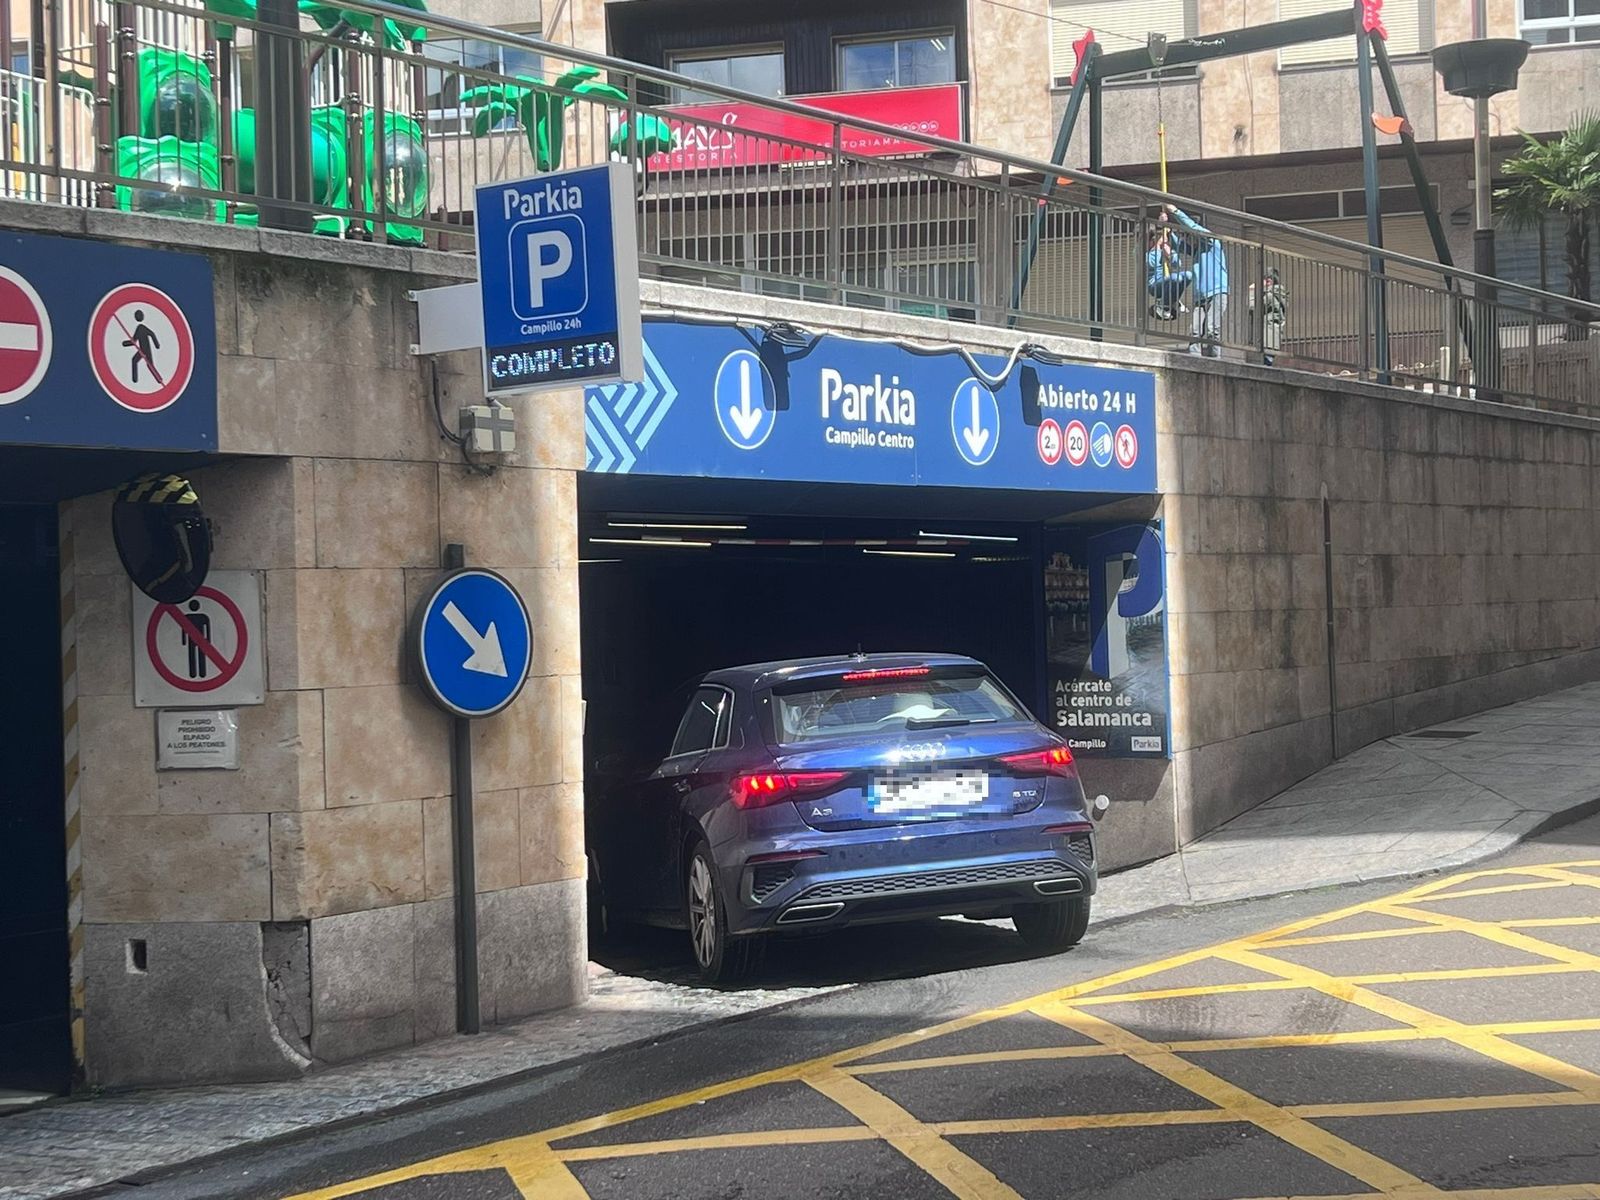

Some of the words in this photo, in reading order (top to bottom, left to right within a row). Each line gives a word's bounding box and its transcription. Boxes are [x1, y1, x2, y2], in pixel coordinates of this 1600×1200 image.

[503, 180, 583, 220] Parkia
[527, 230, 573, 309] P
[520, 319, 563, 336] Campillo
[563, 317, 582, 330] 24h
[491, 341, 616, 378] COMPLETO
[821, 367, 916, 426] Parkia
[1036, 383, 1099, 411] Abierto
[1102, 390, 1121, 413] 24
[1125, 392, 1136, 414] H
[825, 426, 876, 448] Campillo
[877, 430, 915, 449] Centro
[1070, 436, 1083, 451] 20
[1055, 678, 1112, 693] Acércate
[1056, 694, 1069, 707] al
[1070, 694, 1113, 707] centro
[1115, 693, 1132, 707] de
[1056, 709, 1152, 727] Salamanca
[1068, 738, 1107, 749] Campillo
[1133, 738, 1160, 749] Parkia
